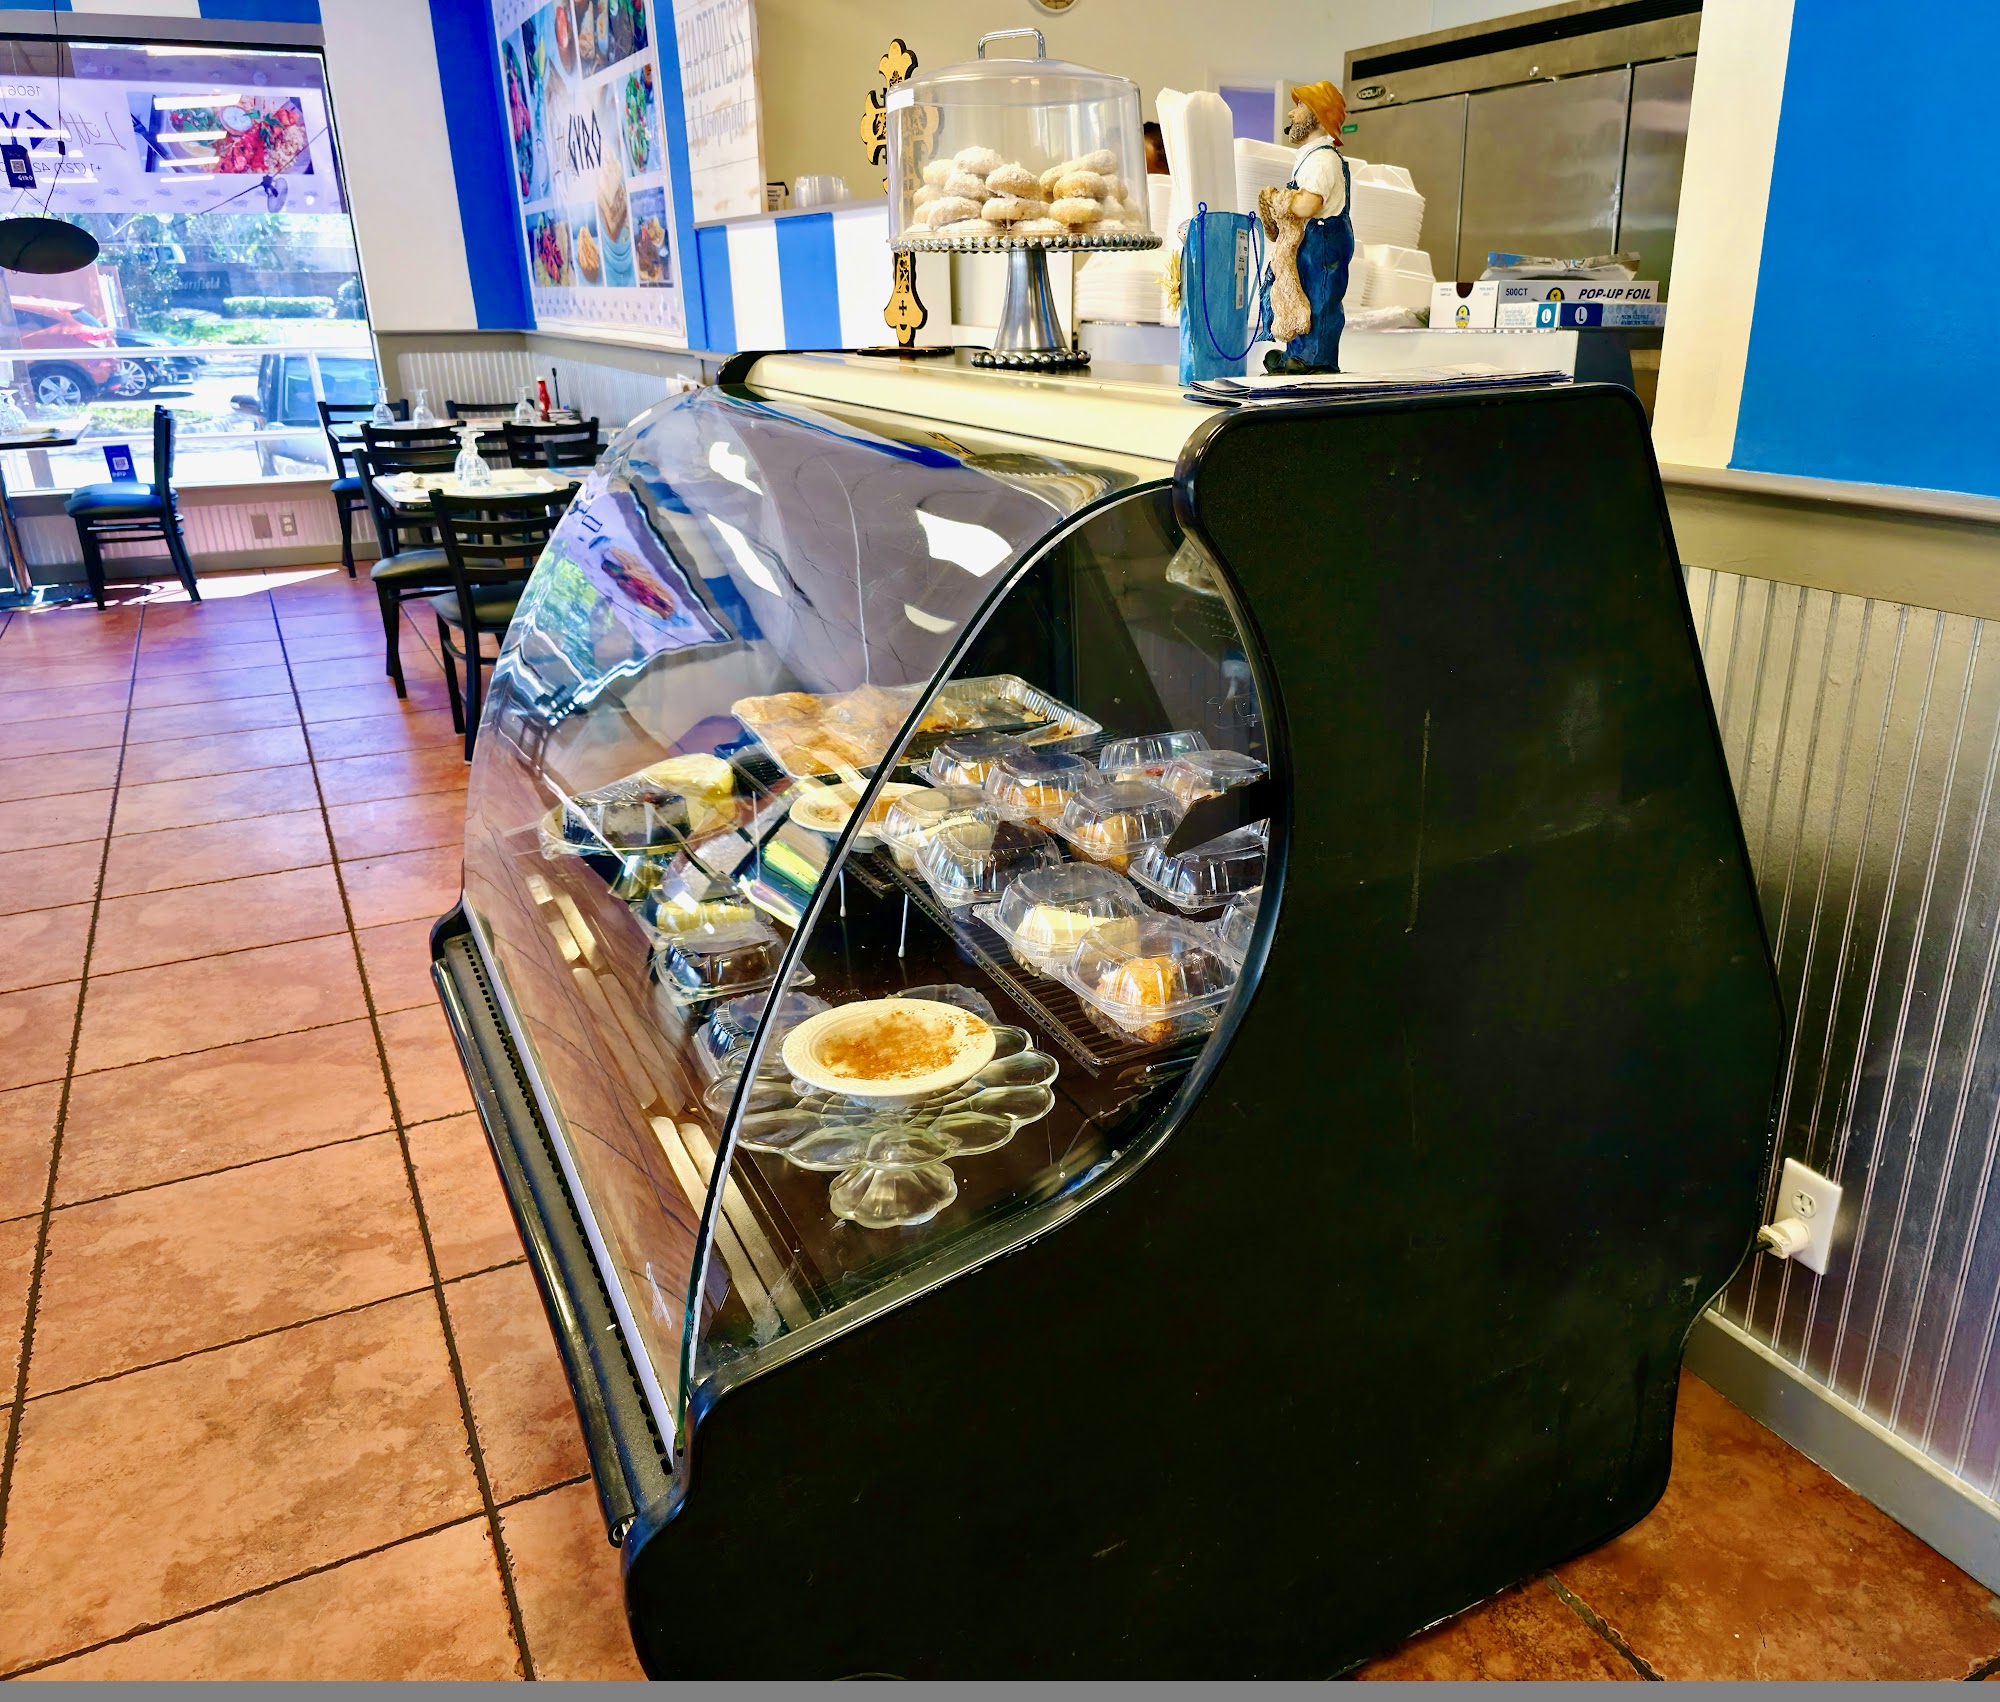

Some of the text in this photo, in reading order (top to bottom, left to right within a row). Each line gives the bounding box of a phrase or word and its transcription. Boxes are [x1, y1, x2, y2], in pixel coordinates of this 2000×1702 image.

[681, 0, 747, 98] HAPPINESS
[567, 108, 602, 178] GYRO
[1505, 287, 1529, 297] 500CT
[1578, 288, 1651, 300] POP-UP FOIL
